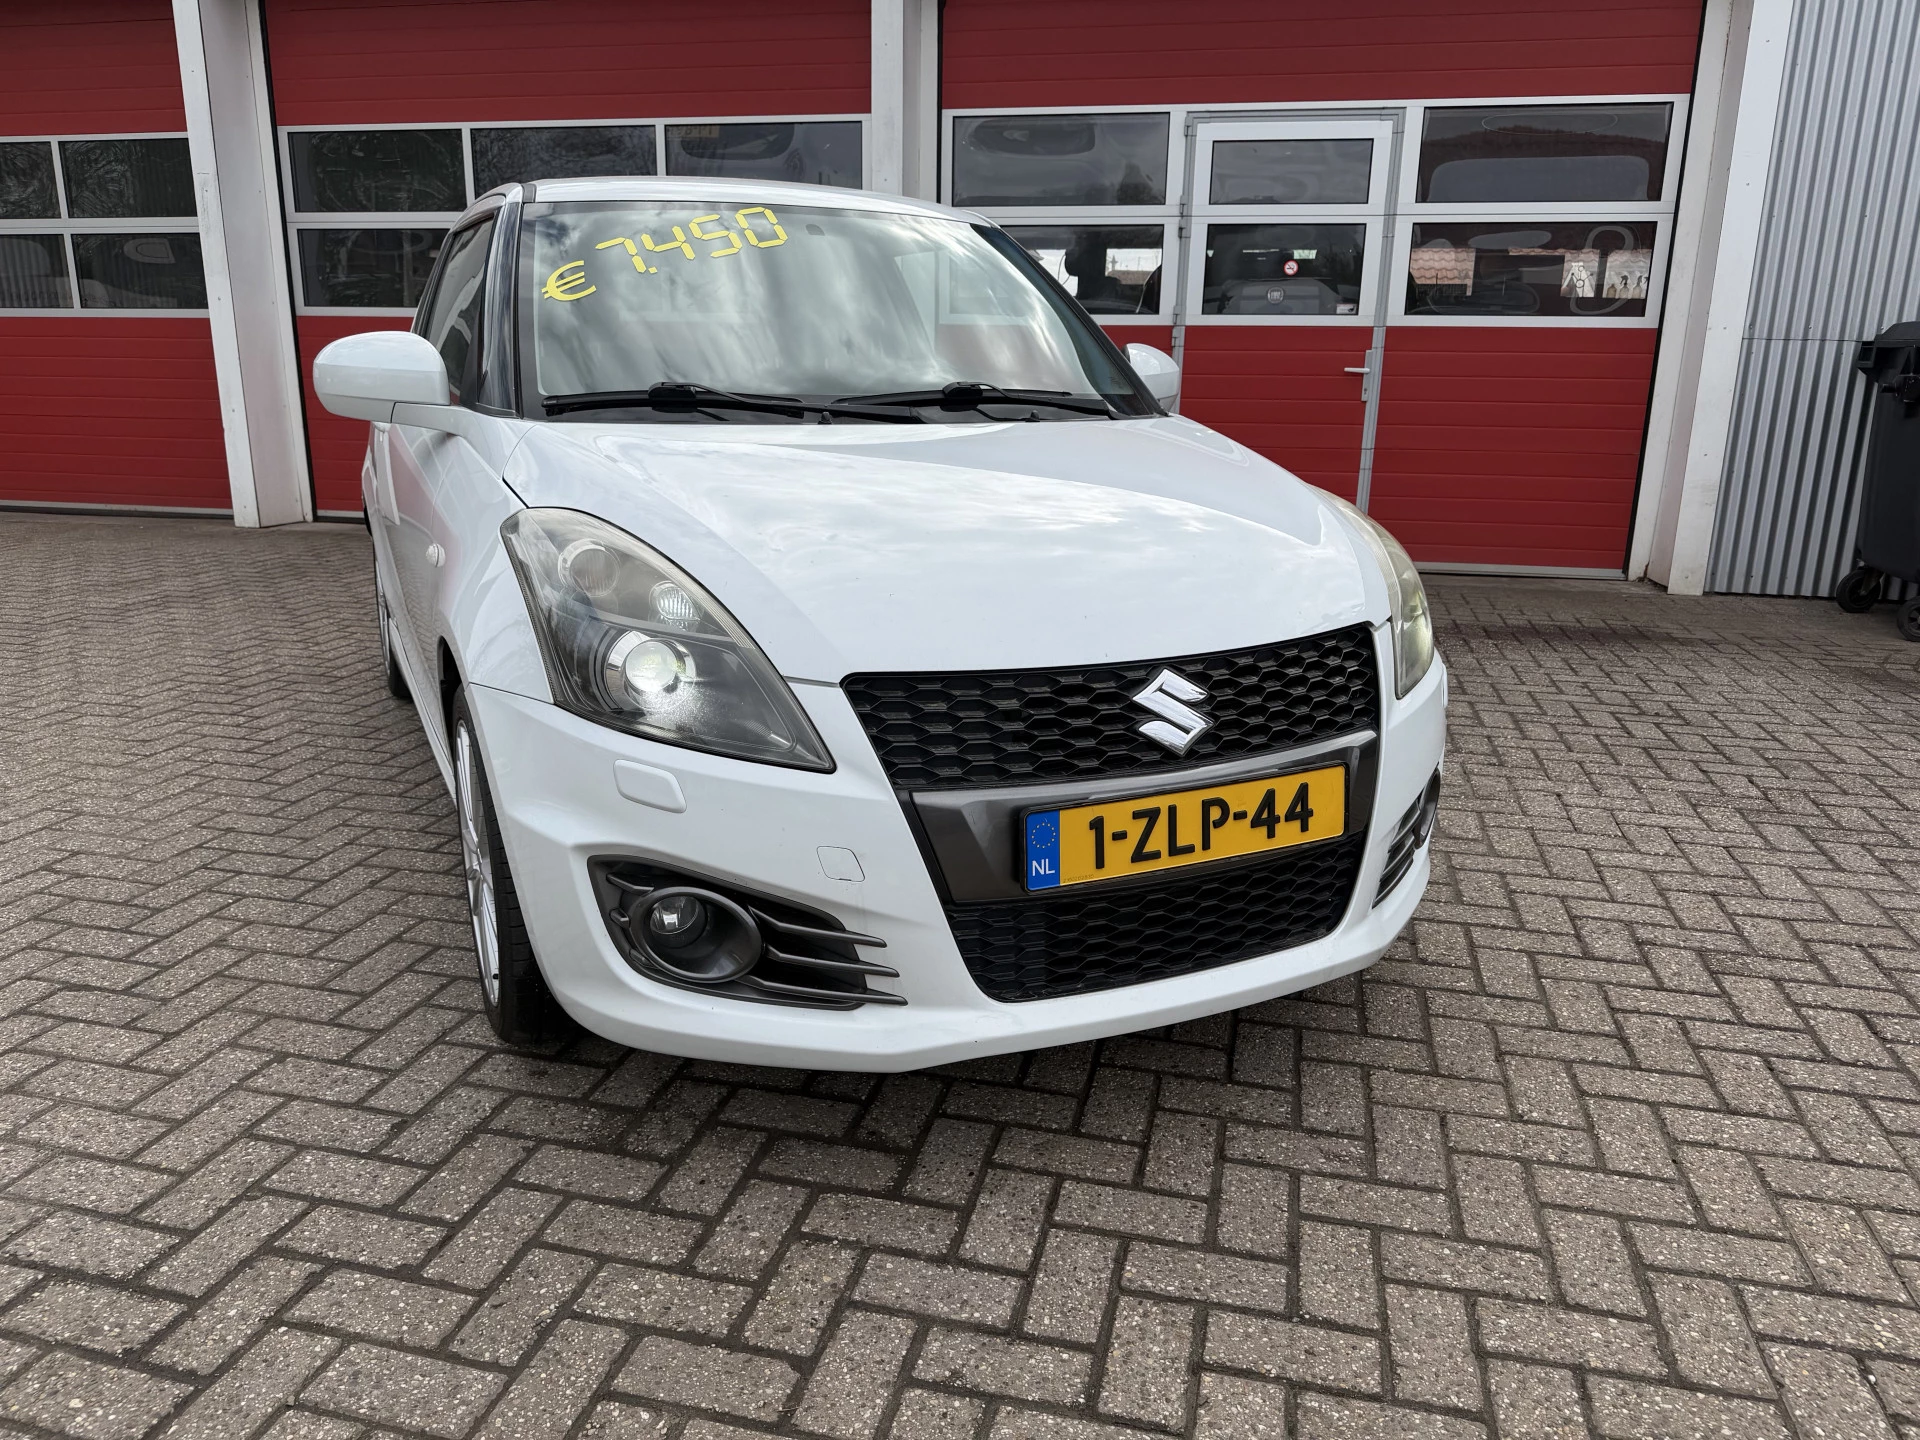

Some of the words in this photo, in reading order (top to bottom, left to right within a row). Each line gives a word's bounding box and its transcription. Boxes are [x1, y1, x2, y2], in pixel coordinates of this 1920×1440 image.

[541, 260, 597, 301] €
[595, 206, 788, 274] 7.450
[1031, 858, 1056, 877] NL
[1089, 782, 1314, 869] 1-ZLP-44
